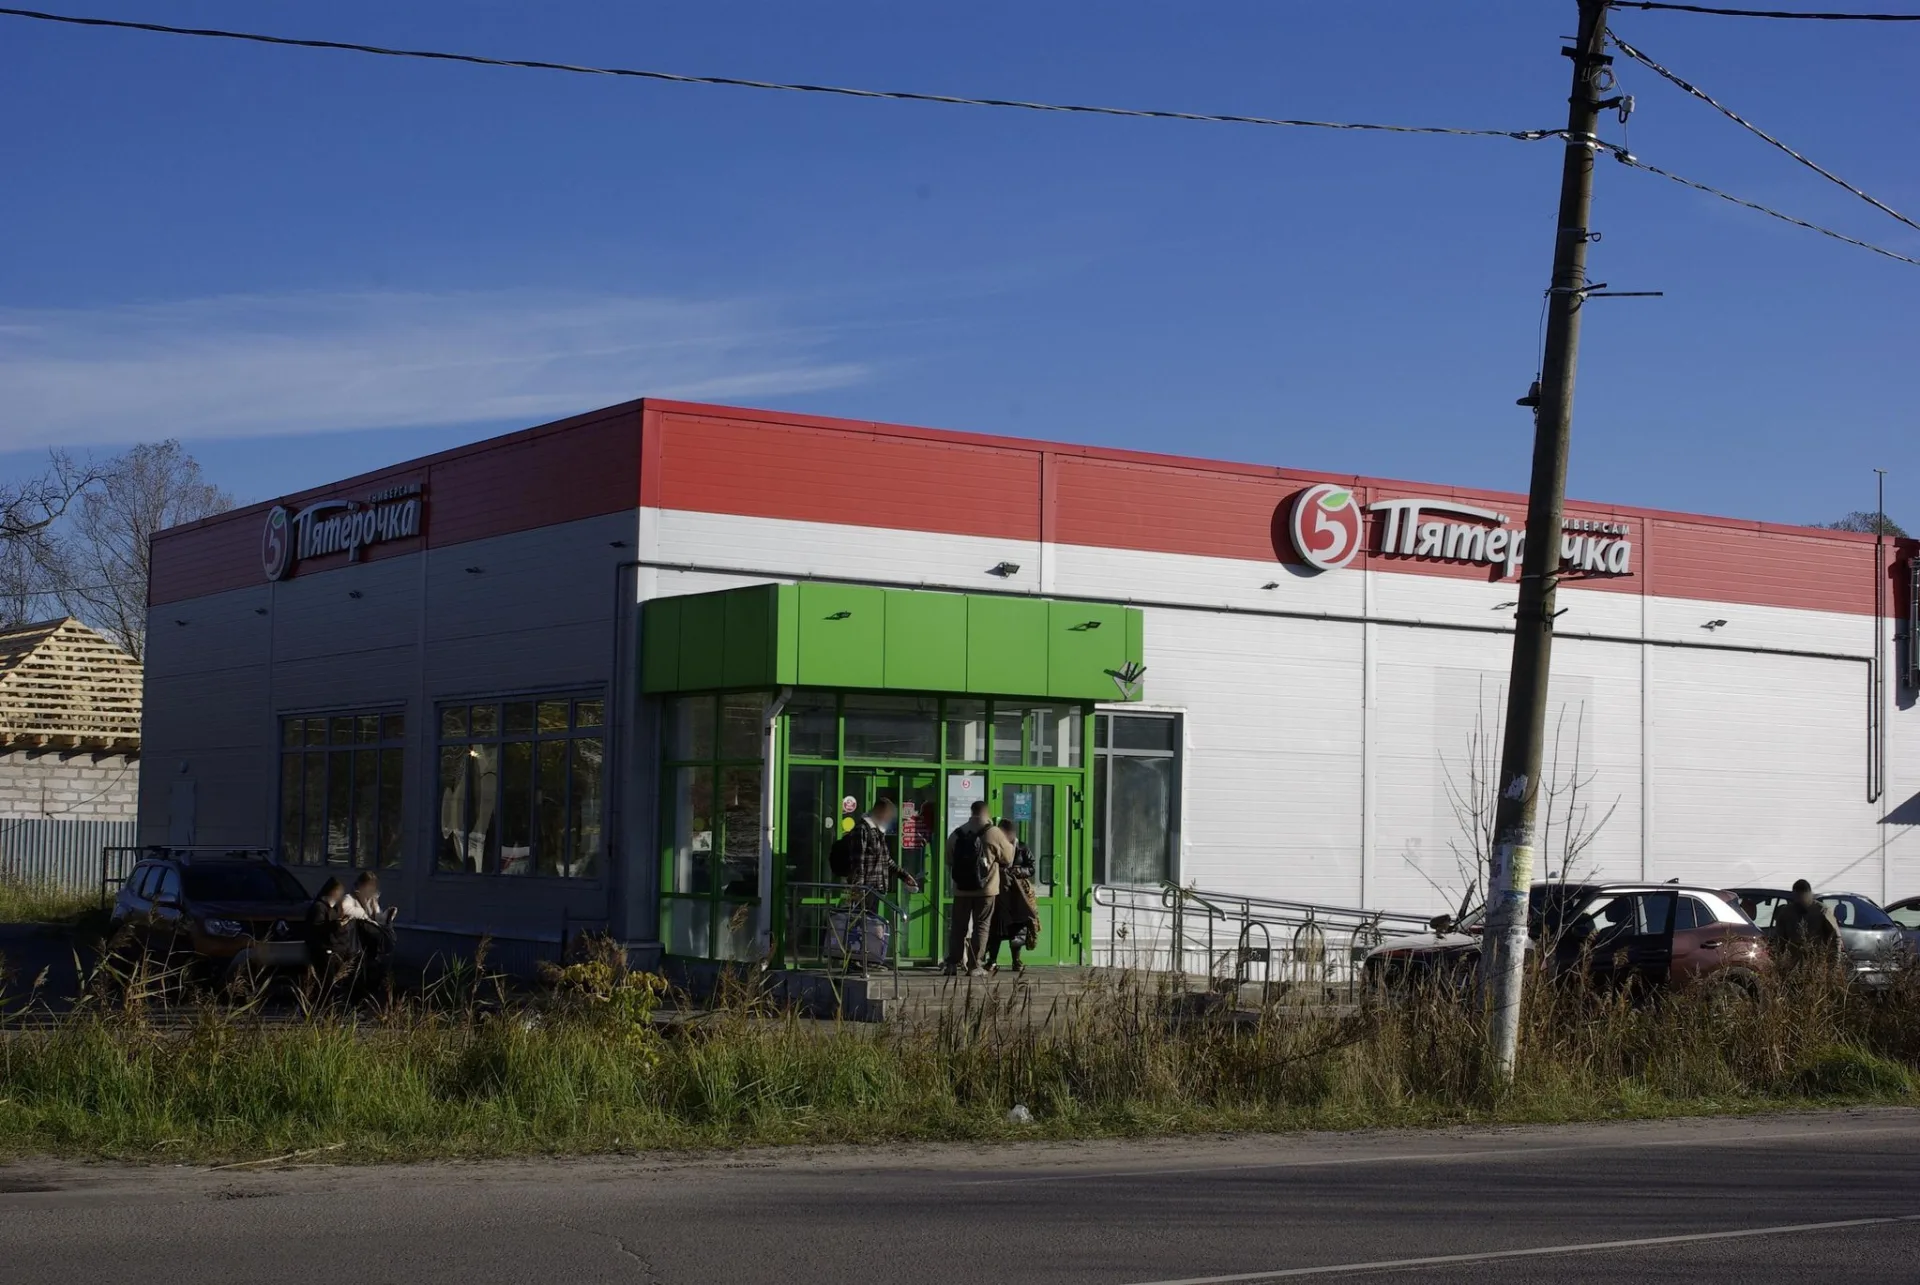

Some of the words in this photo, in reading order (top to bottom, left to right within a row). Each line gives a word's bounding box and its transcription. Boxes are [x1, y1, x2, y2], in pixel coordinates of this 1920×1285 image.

[292, 499, 418, 562] Пятёрочка
[1370, 498, 1632, 578] Пятёрчка
[1561, 518, 1630, 535] ИВЕРСАМ
